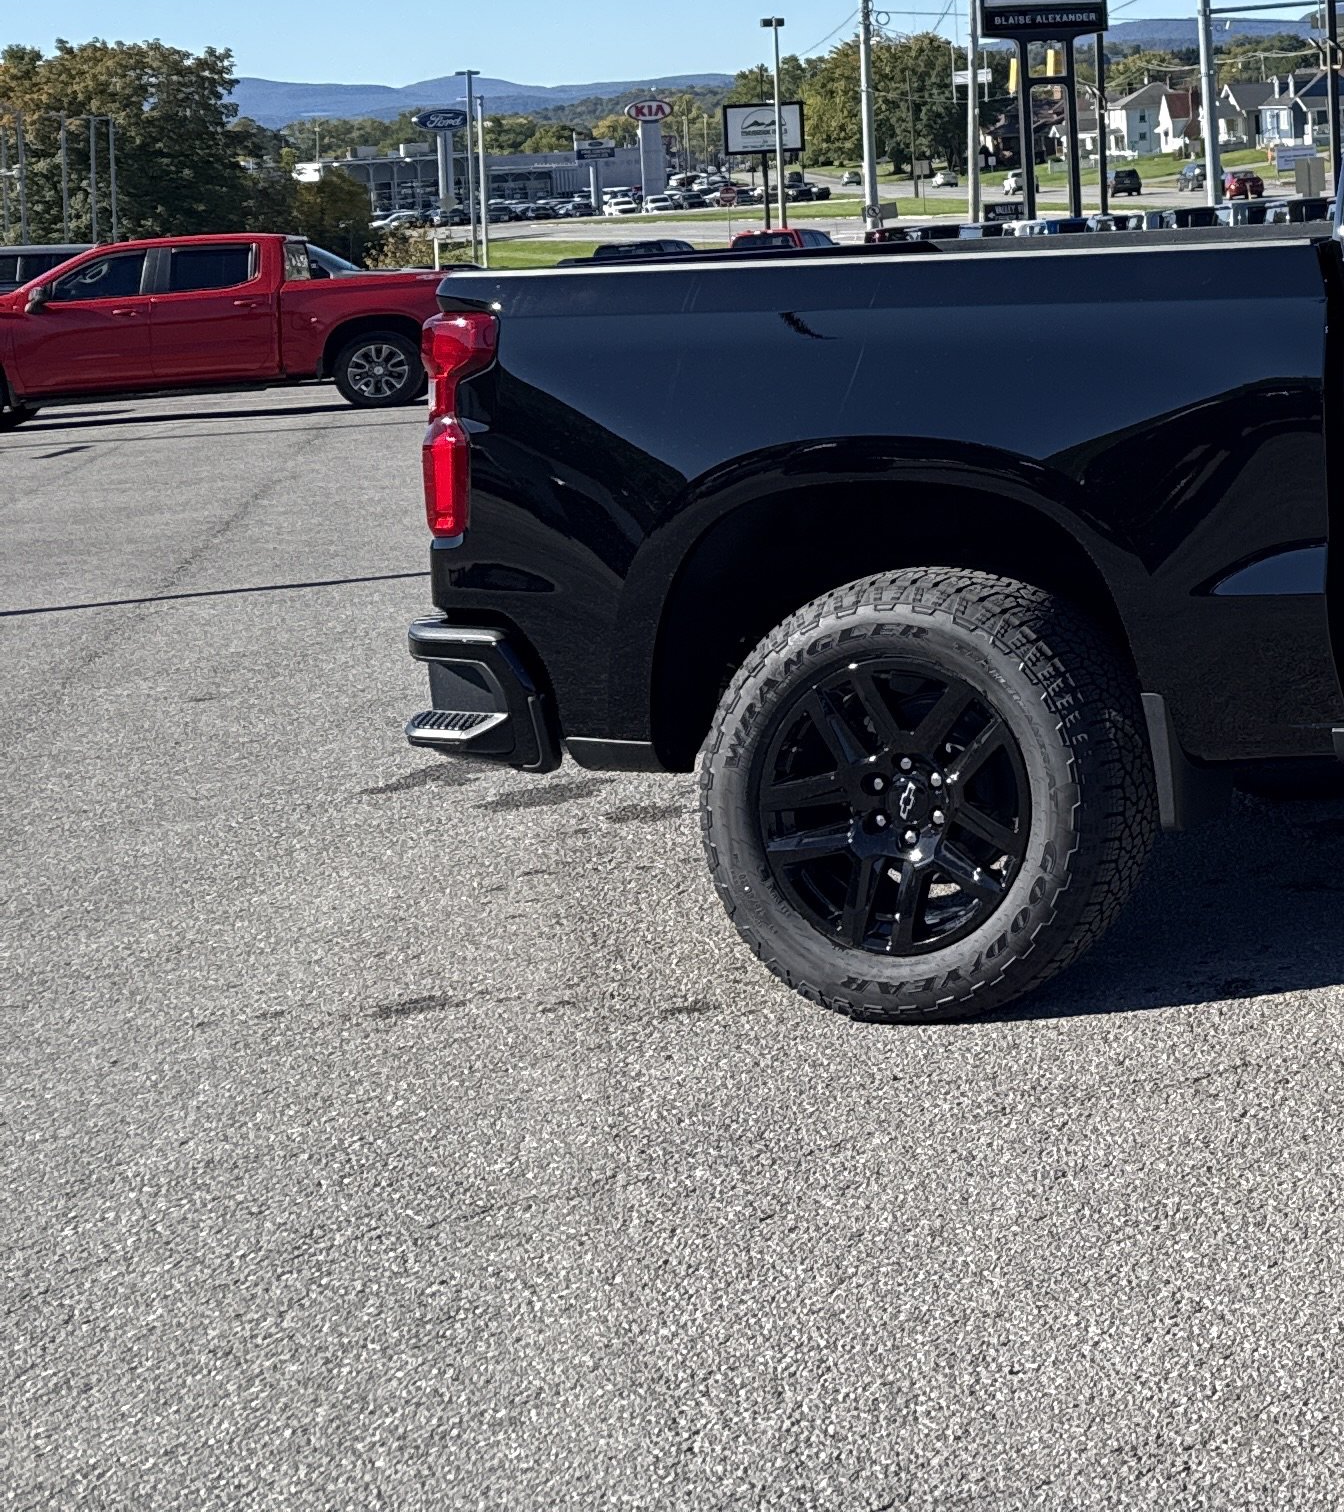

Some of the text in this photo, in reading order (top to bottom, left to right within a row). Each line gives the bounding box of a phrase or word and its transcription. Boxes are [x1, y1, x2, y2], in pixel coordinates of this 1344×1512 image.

[994, 13, 1096, 25] BLAISE ALEXANDER
[634, 104, 667, 117] KIA
[427, 113, 464, 128] Ford
[722, 622, 929, 769] WRANGLER
[841, 840, 1058, 995] GOODYEAR
